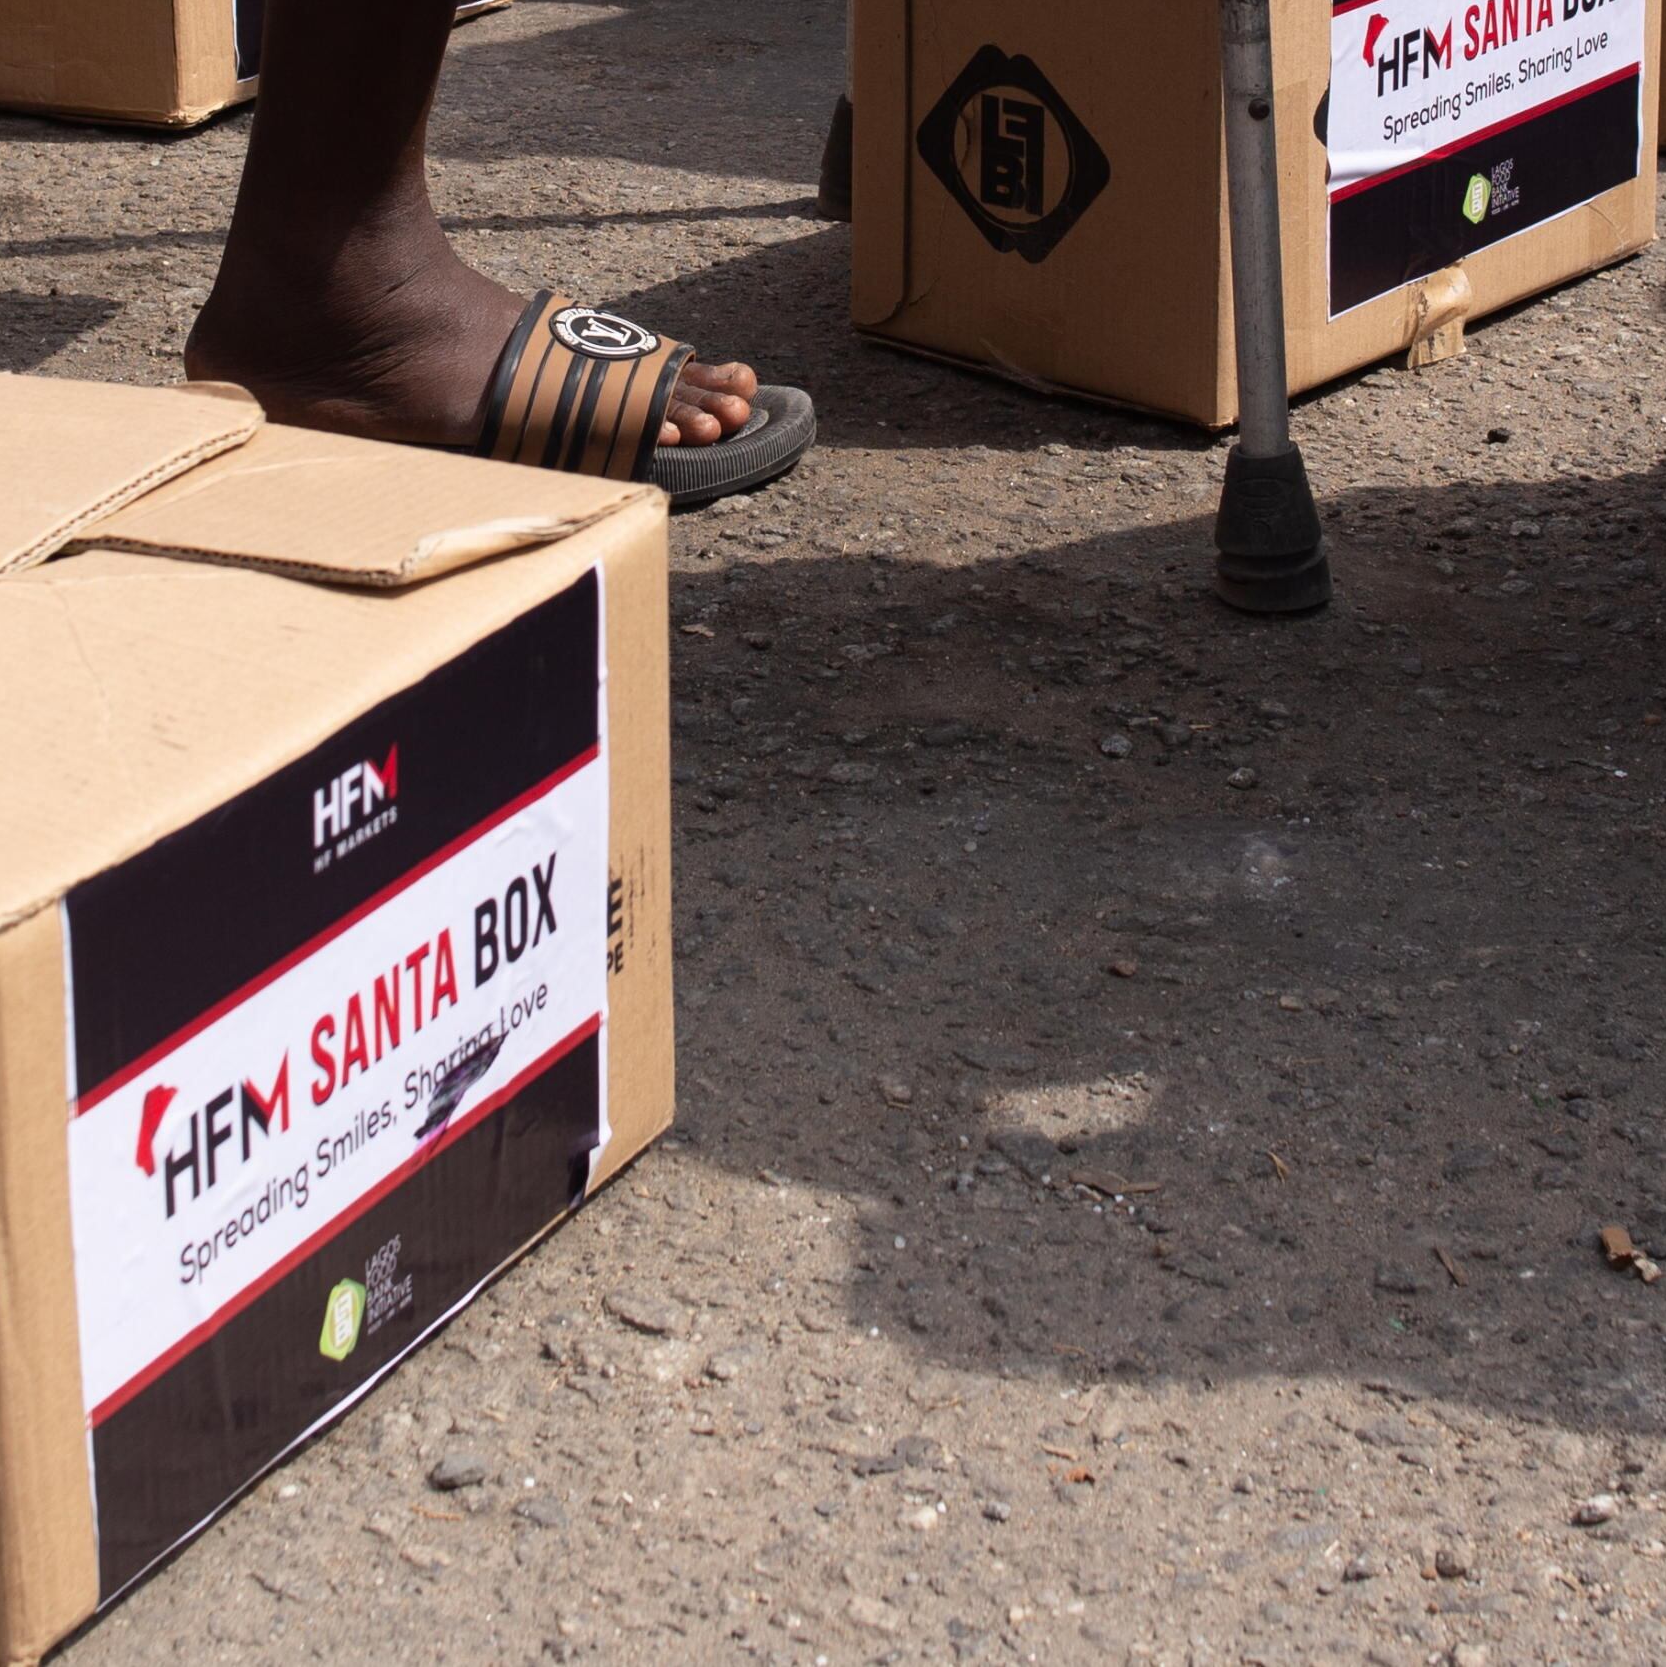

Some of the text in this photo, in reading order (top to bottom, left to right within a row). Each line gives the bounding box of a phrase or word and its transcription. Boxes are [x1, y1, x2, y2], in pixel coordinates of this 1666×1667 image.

[1377, 16, 1453, 98] HFM
[1383, 31, 1608, 144] Spreading Smiles, Sharing Love
[313, 742, 398, 849] HFM
[313, 805, 398, 875] HF MARKETS
[165, 851, 558, 1220] HFM SANTA BOX
[180, 1163, 310, 1285] Spreading
[316, 1101, 398, 1182] Smiles,
[499, 982, 548, 1038] Love
